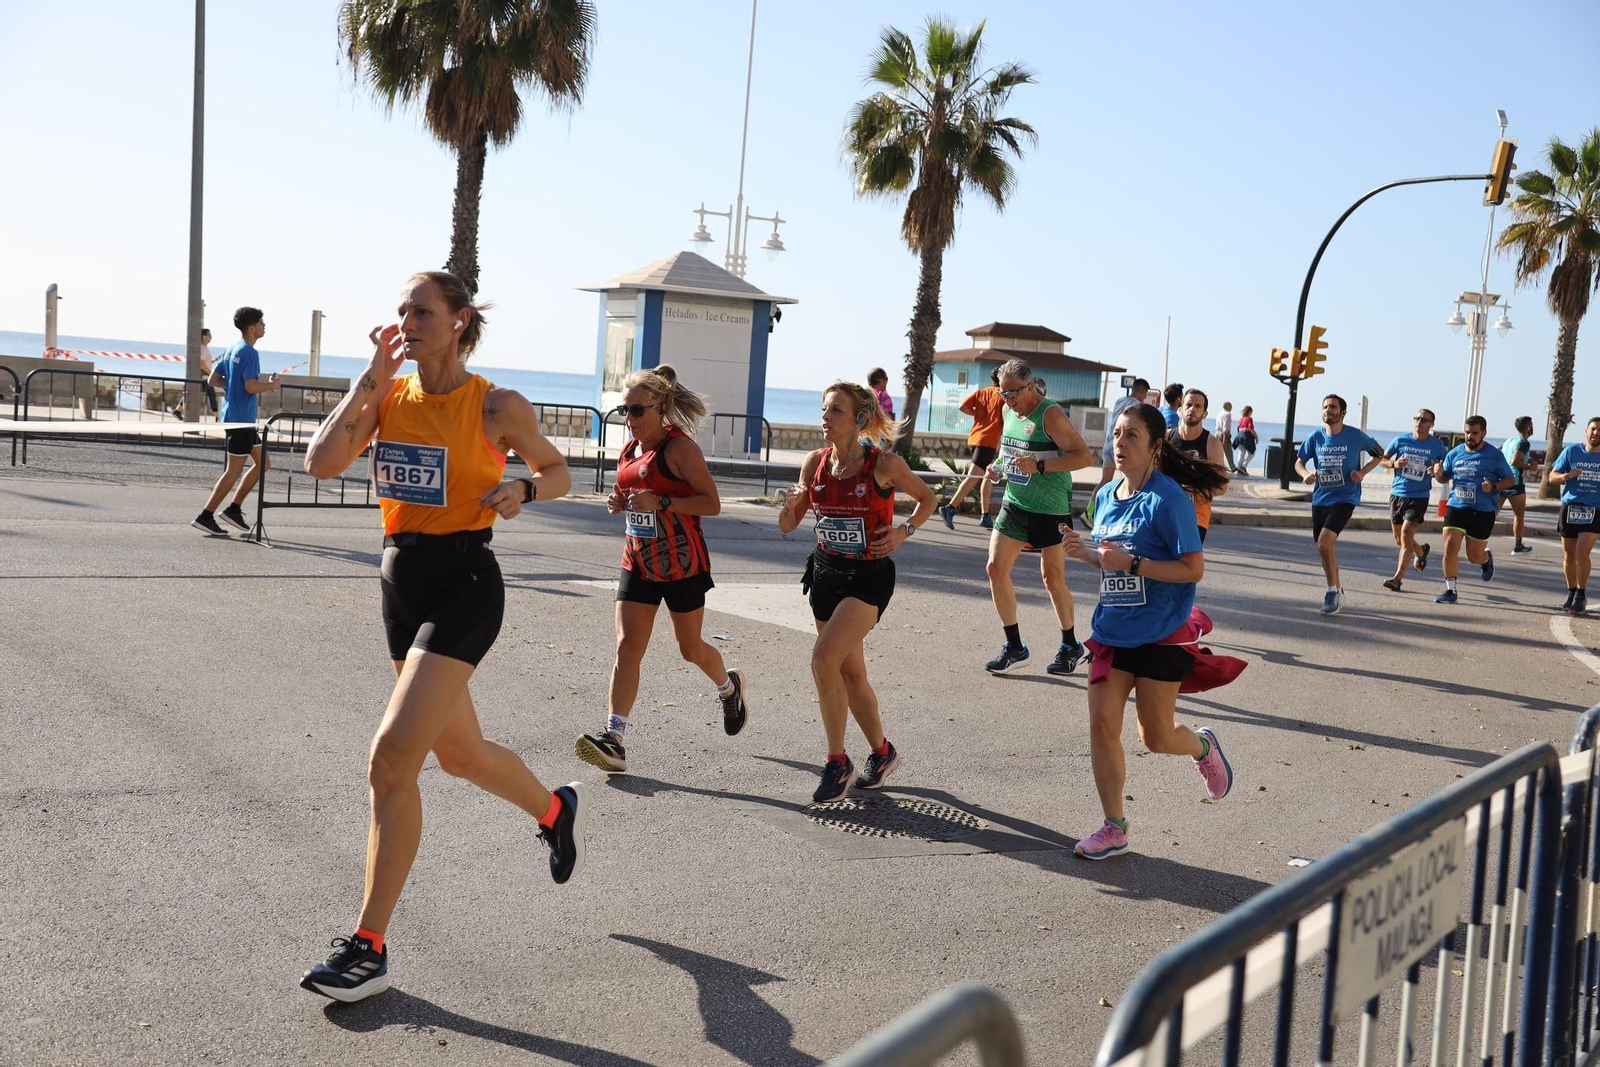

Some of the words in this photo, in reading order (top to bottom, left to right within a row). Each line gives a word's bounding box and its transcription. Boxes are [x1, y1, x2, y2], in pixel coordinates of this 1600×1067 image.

[665, 307, 698, 320] Helados
[706, 311, 718, 322] Ice
[720, 312, 750, 324] Creams
[1318, 445, 1348, 453] mayoral
[1404, 446, 1431, 455] mayoral
[381, 464, 436, 486] 1867
[820, 530, 858, 542] 1602
[1104, 578, 1137, 592] 1905
[1351, 863, 1413, 944] POLICIA
[1417, 835, 1458, 898] LOCAL
[1374, 899, 1434, 981] MALAGA
